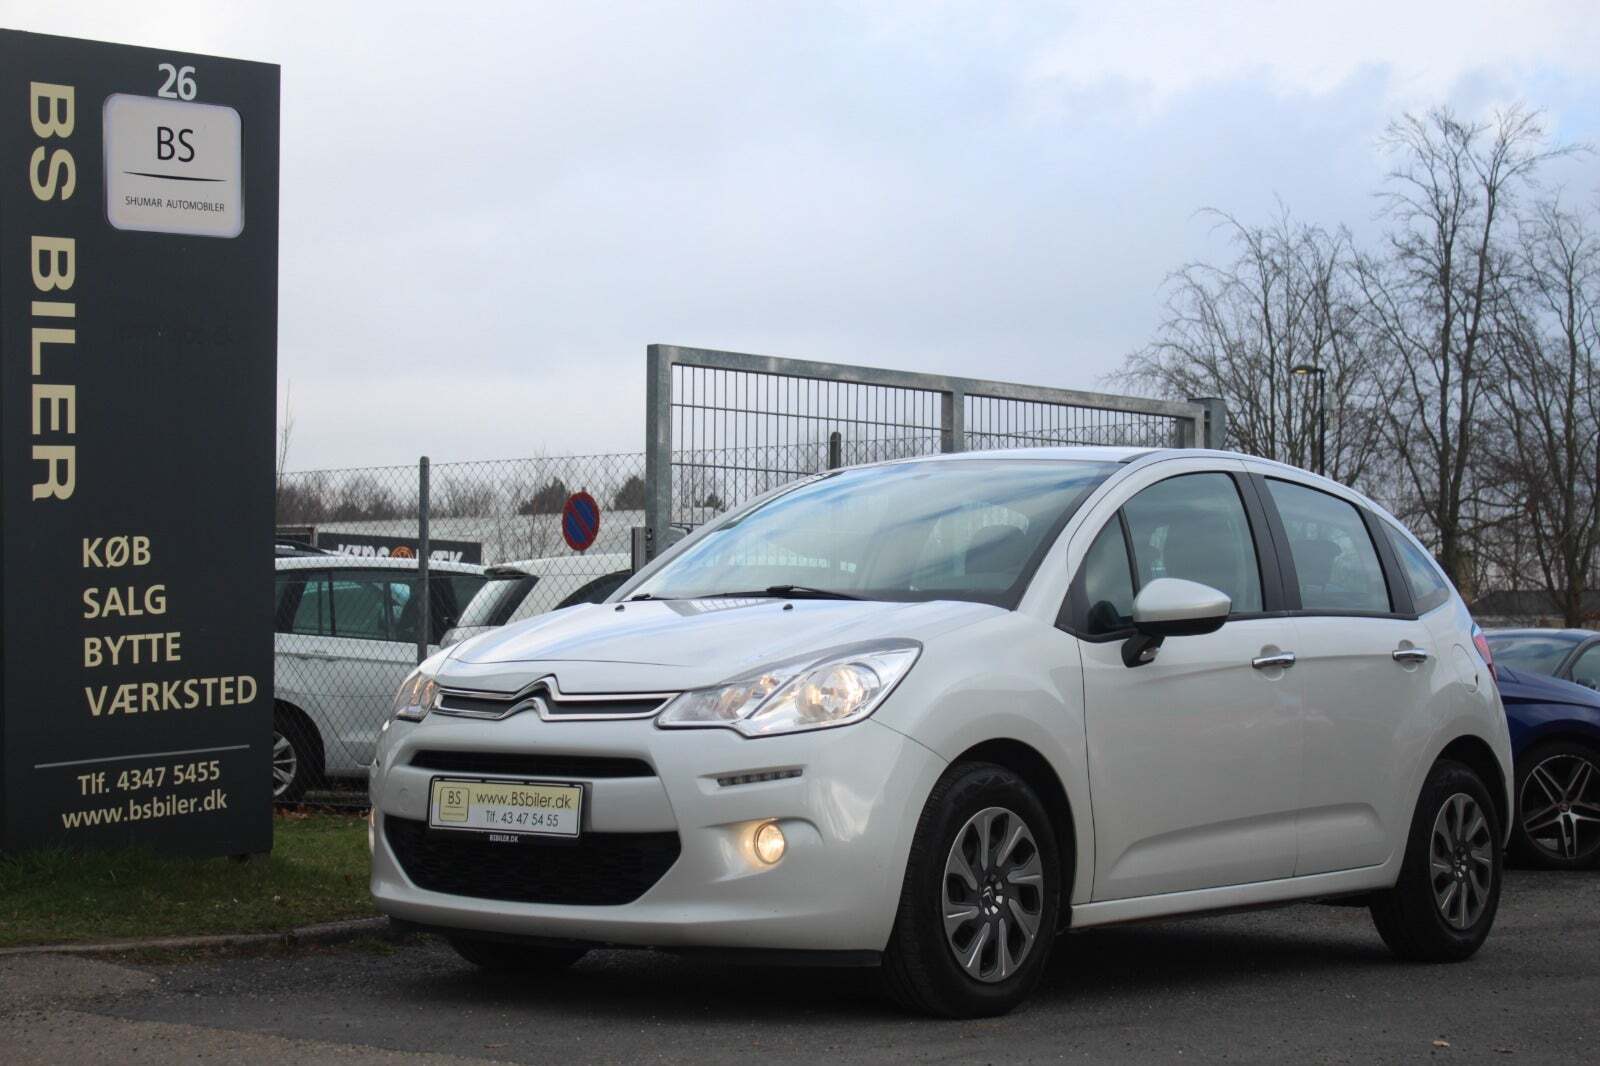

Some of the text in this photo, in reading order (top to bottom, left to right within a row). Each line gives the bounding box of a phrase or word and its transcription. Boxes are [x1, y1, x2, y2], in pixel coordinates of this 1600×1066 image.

[157, 63, 197, 101] 26
[156, 126, 195, 163] BS
[125, 195, 225, 213] SHUMAR AUTOMOBILER
[29, 81, 77, 501] BS BILER
[82, 535, 152, 569] KØB
[83, 584, 168, 619] SALG
[84, 631, 182, 668] BYTTE
[85, 675, 258, 717] VÆRKSTED
[78, 760, 220, 796] Tlf. 4347 5455
[62, 789, 228, 829] www.bsbiler.dk
[448, 790, 462, 805] BS
[476, 792, 572, 810] www.BSbiler.dk
[500, 812, 514, 825] 43
[516, 813, 529, 825] 47
[531, 813, 544, 827] 54
[546, 814, 559, 828] 55
